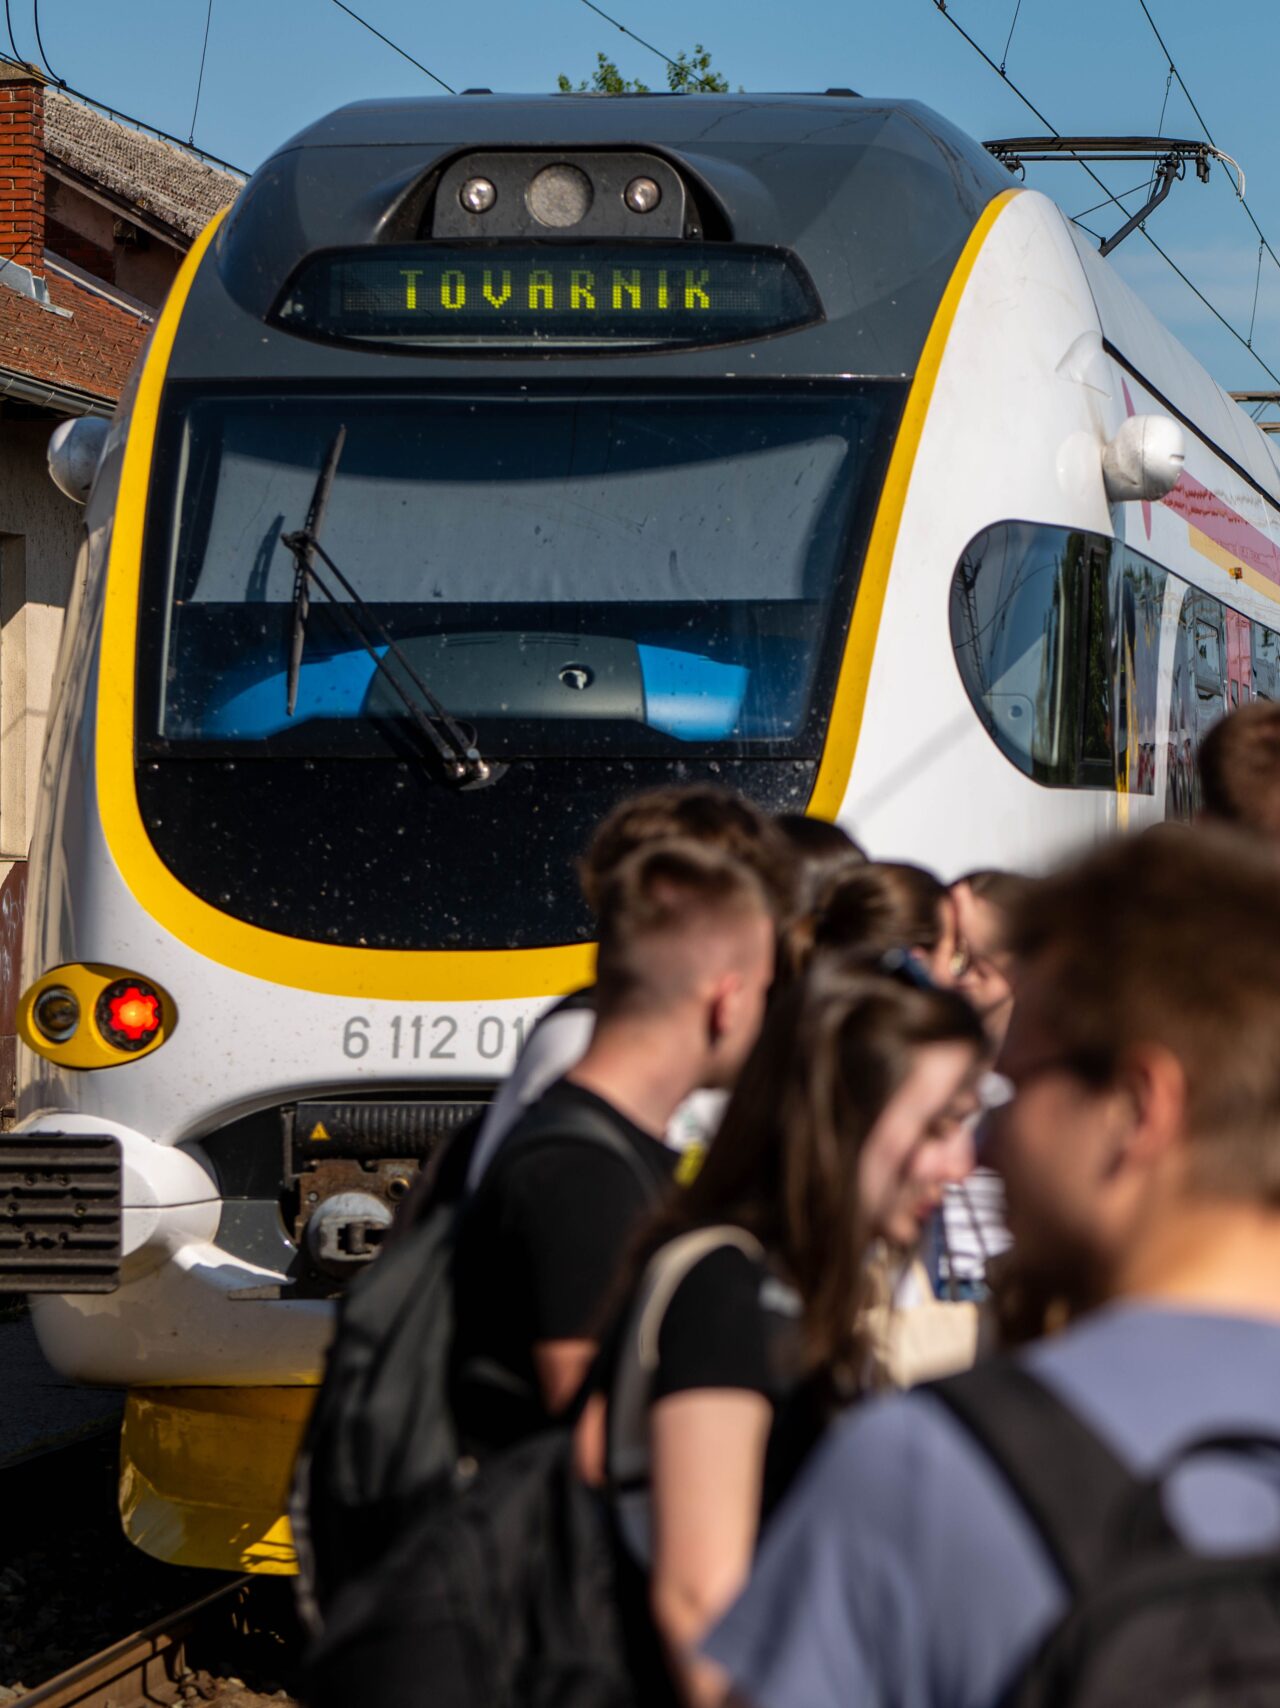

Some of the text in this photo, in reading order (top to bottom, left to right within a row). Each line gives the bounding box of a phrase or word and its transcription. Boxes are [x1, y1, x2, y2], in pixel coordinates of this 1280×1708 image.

[399, 269, 710, 310] TOVARNIK
[342, 1015, 371, 1060] 6
[390, 1014, 458, 1060] 112
